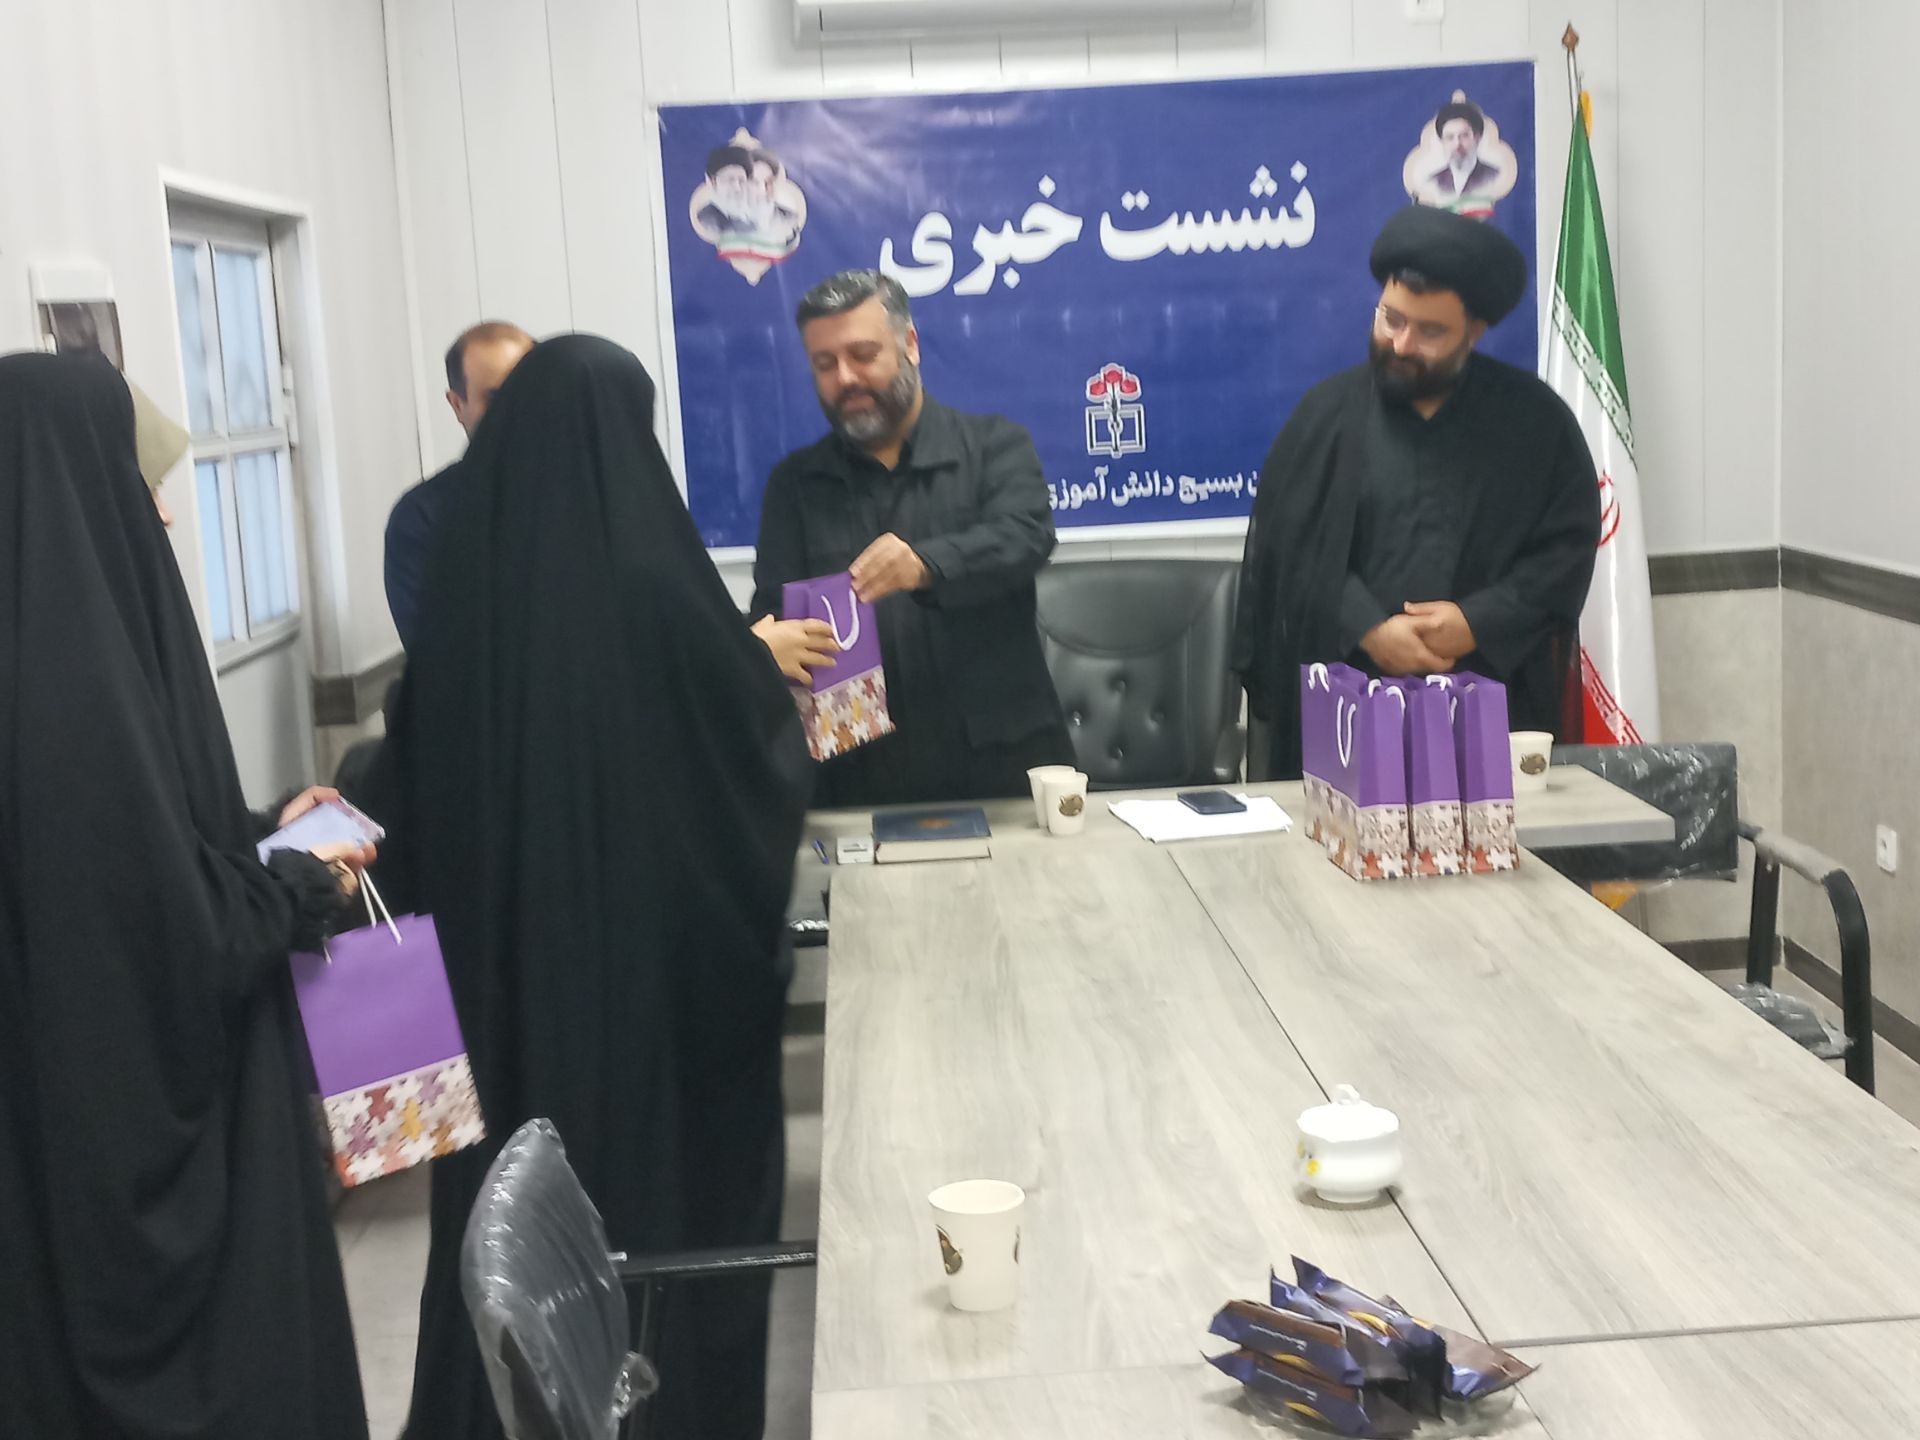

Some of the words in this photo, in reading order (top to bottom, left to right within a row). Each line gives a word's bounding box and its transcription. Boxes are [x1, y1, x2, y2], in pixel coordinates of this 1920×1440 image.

[879, 174, 1084, 298] خبری
[1099, 159, 1316, 262] نشست
[1111, 469, 1175, 507] دانش
[1178, 471, 1243, 504] بسیج
